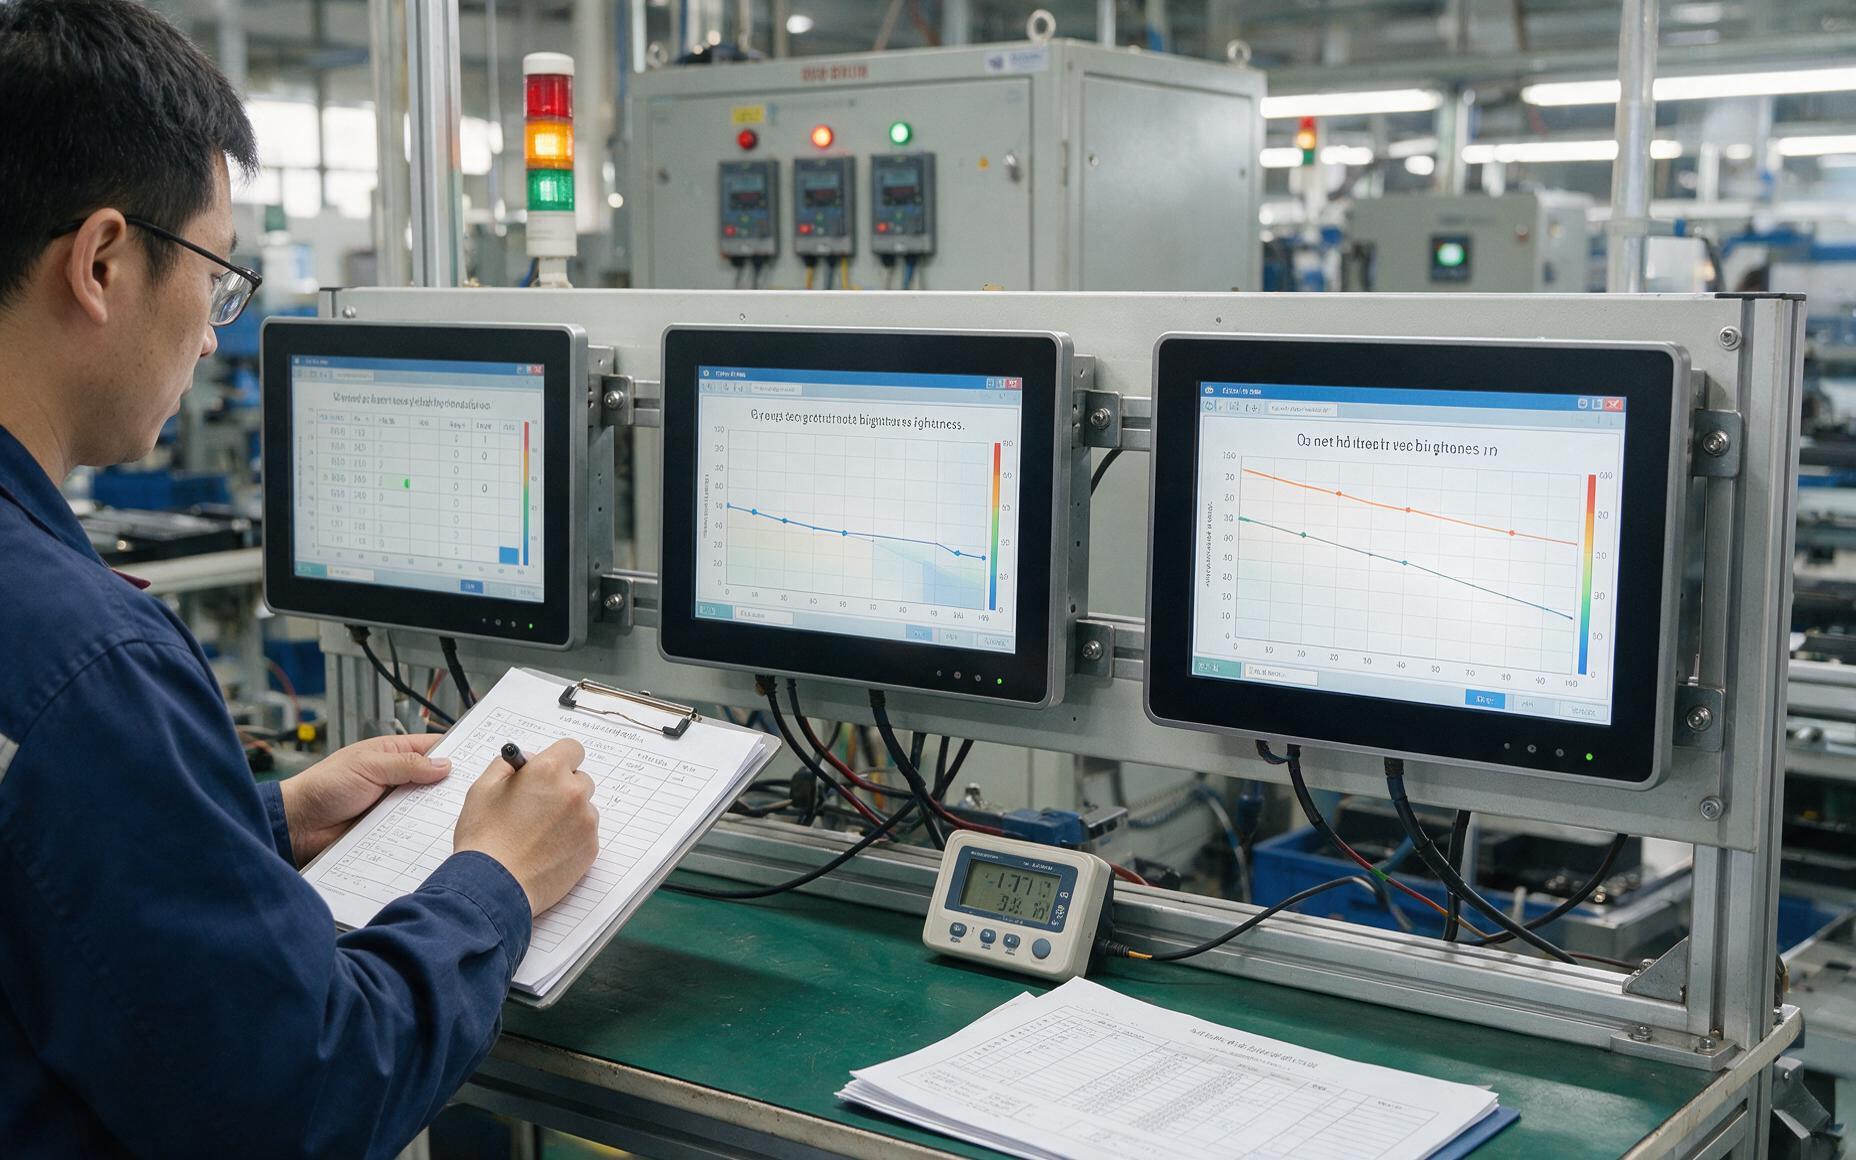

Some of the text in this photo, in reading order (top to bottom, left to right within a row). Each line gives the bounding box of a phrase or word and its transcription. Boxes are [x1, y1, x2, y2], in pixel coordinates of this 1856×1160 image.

[1221, 612, 1230, 620] 10
[1225, 632, 1230, 640] 0
[1233, 642, 1238, 650] 0
